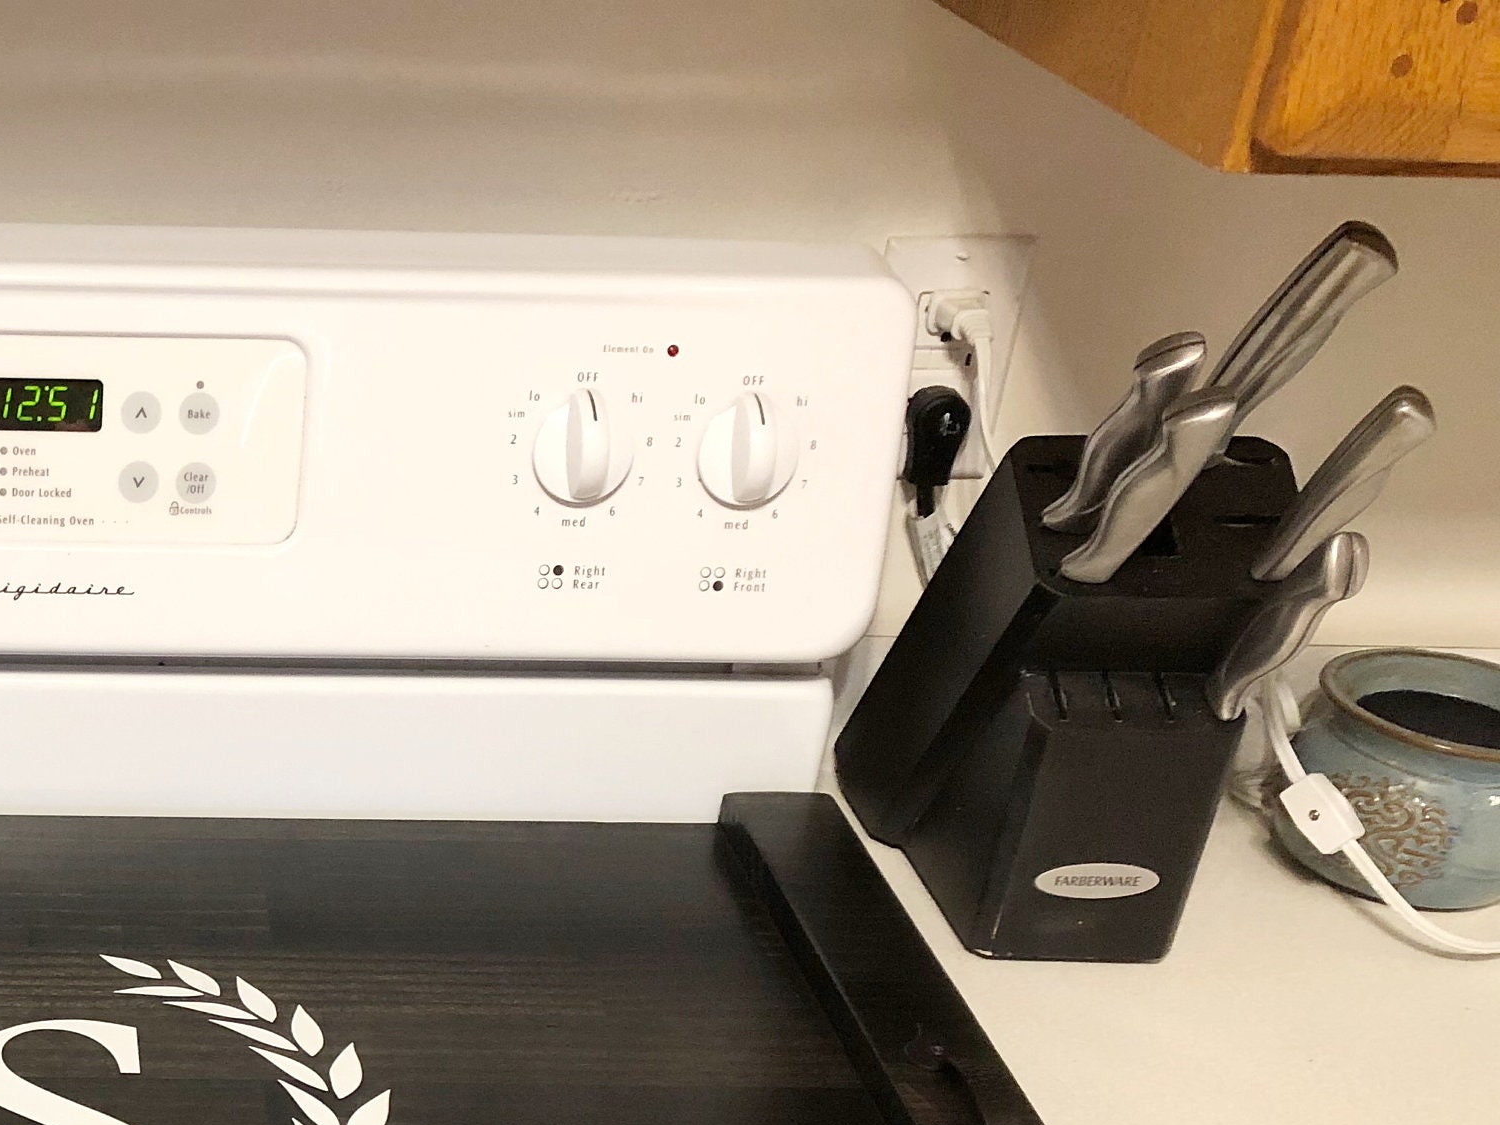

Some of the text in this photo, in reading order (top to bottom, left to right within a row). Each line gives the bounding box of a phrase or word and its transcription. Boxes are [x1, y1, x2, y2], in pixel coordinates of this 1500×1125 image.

[577, 371, 599, 383] OFF
[742, 375, 764, 386] OFF
[529, 389, 541, 402] lo
[631, 391, 643, 403] hi
[694, 393, 706, 405] lo
[796, 395, 808, 407] hi
[187, 408, 211, 420] Bake
[508, 410, 526, 418] sim
[673, 414, 692, 422] sim
[510, 434, 517, 444] 2
[646, 437, 654, 446] 8
[674, 437, 682, 447] 2
[12, 445, 37, 456] Oven
[809, 440, 817, 450] 8
[12, 466, 50, 477] Preheat
[183, 471, 209, 483] Clear
[512, 475, 519, 484] 3
[638, 477, 645, 485] 7
[675, 477, 683, 488] 3
[801, 480, 808, 488] 7
[11, 487, 72, 498] Door Locked
[186, 483, 205, 495] /Off
[179, 506, 213, 515] Controls
[533, 507, 540, 515] 4
[609, 506, 616, 516] 6
[696, 509, 703, 518] 4
[771, 509, 779, 519] 6
[69, 515, 95, 526] Oven
[561, 516, 587, 528] med
[724, 519, 749, 530] med
[574, 565, 606, 579] Right
[735, 567, 767, 582] Right
[572, 578, 600, 590] Rear
[733, 581, 766, 593] Front
[1054, 875, 1142, 887] FARBERWARE
